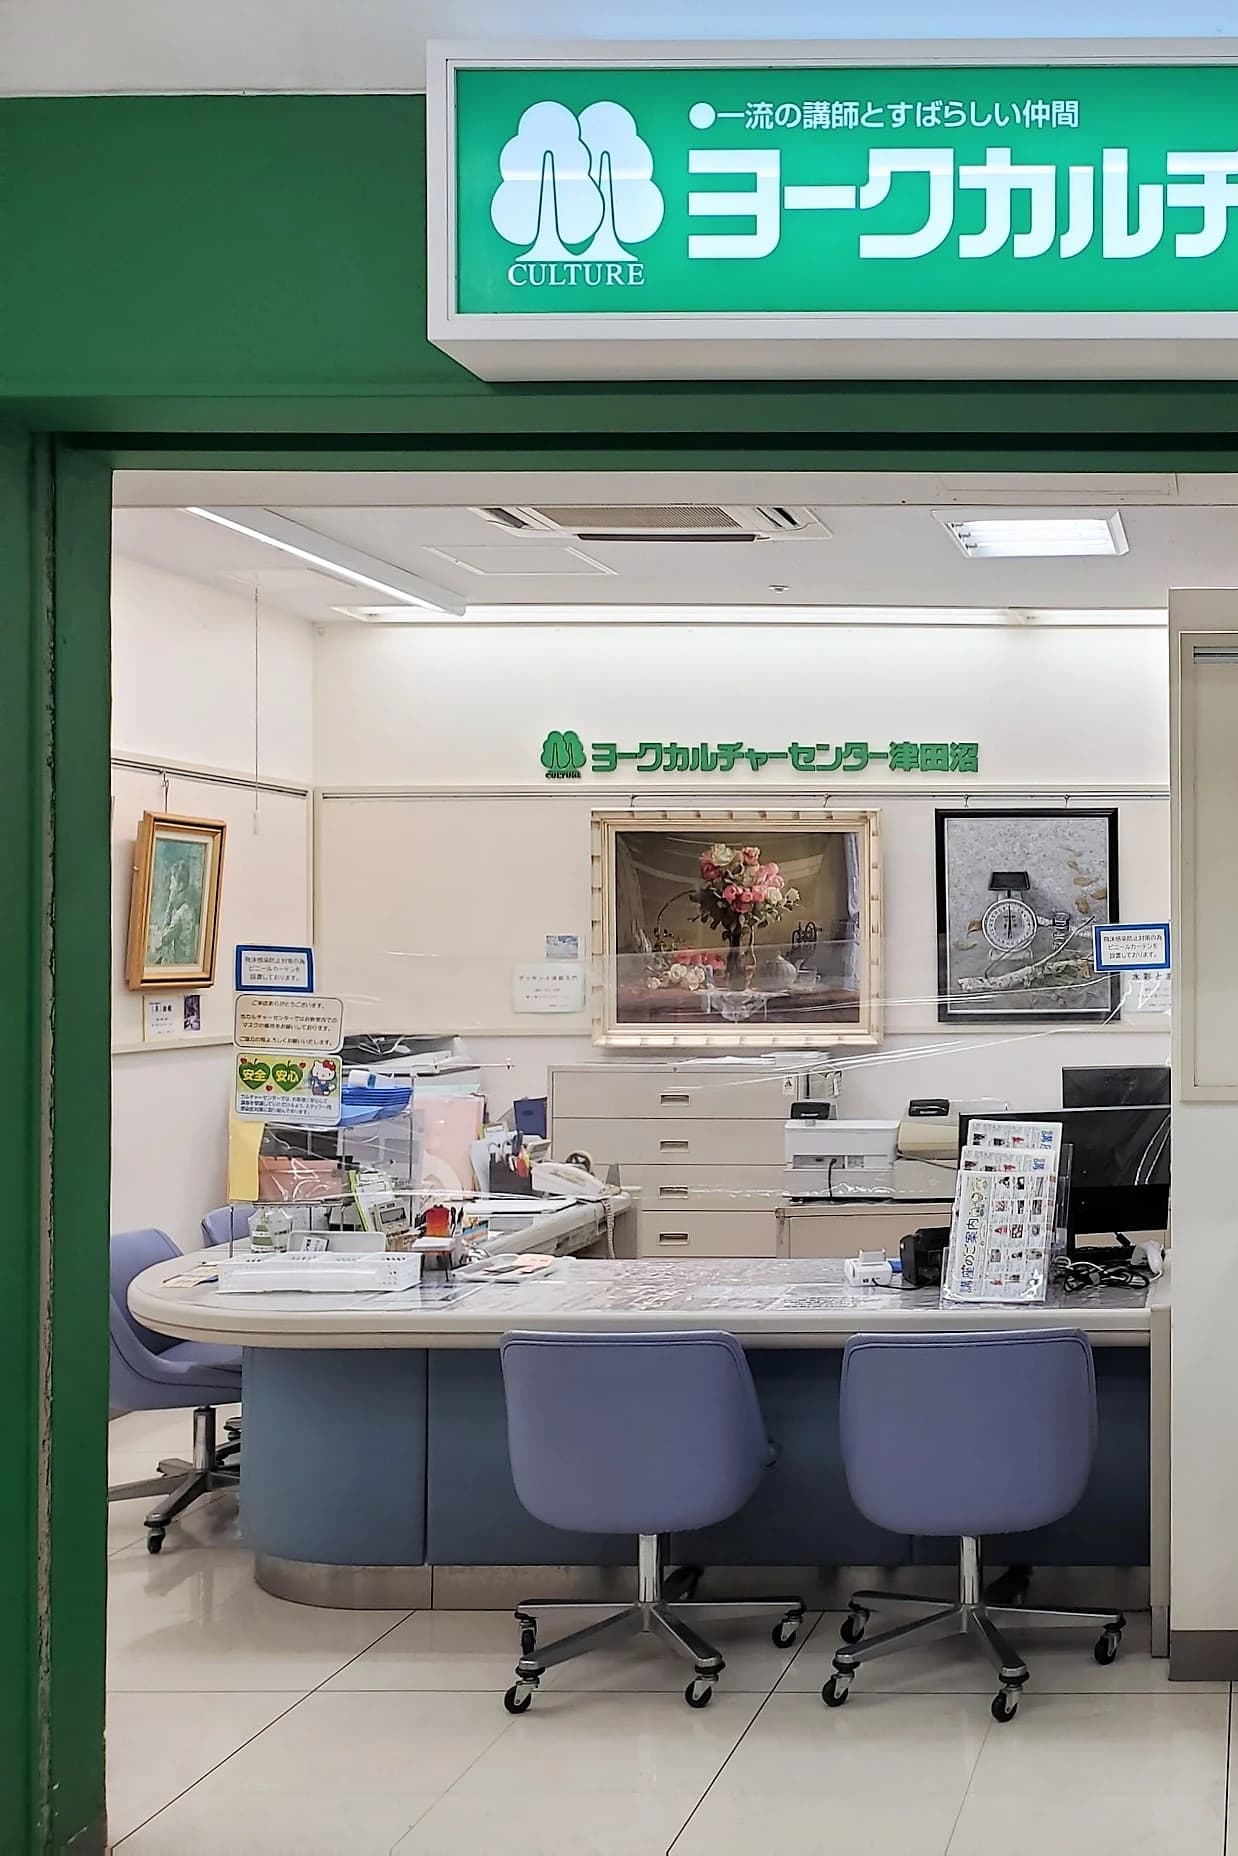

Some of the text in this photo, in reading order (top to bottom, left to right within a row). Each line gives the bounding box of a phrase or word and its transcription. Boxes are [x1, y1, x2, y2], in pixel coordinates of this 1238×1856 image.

[716, 99, 1080, 129] 一流の講師とすばらしい仲間
[507, 262, 646, 287] CULTURE
[591, 740, 980, 773] ヨークカルチャーセンター津田沼
[242, 1069, 299, 1082] 安全 安心
[959, 1217, 979, 1293] 講座のご案内
